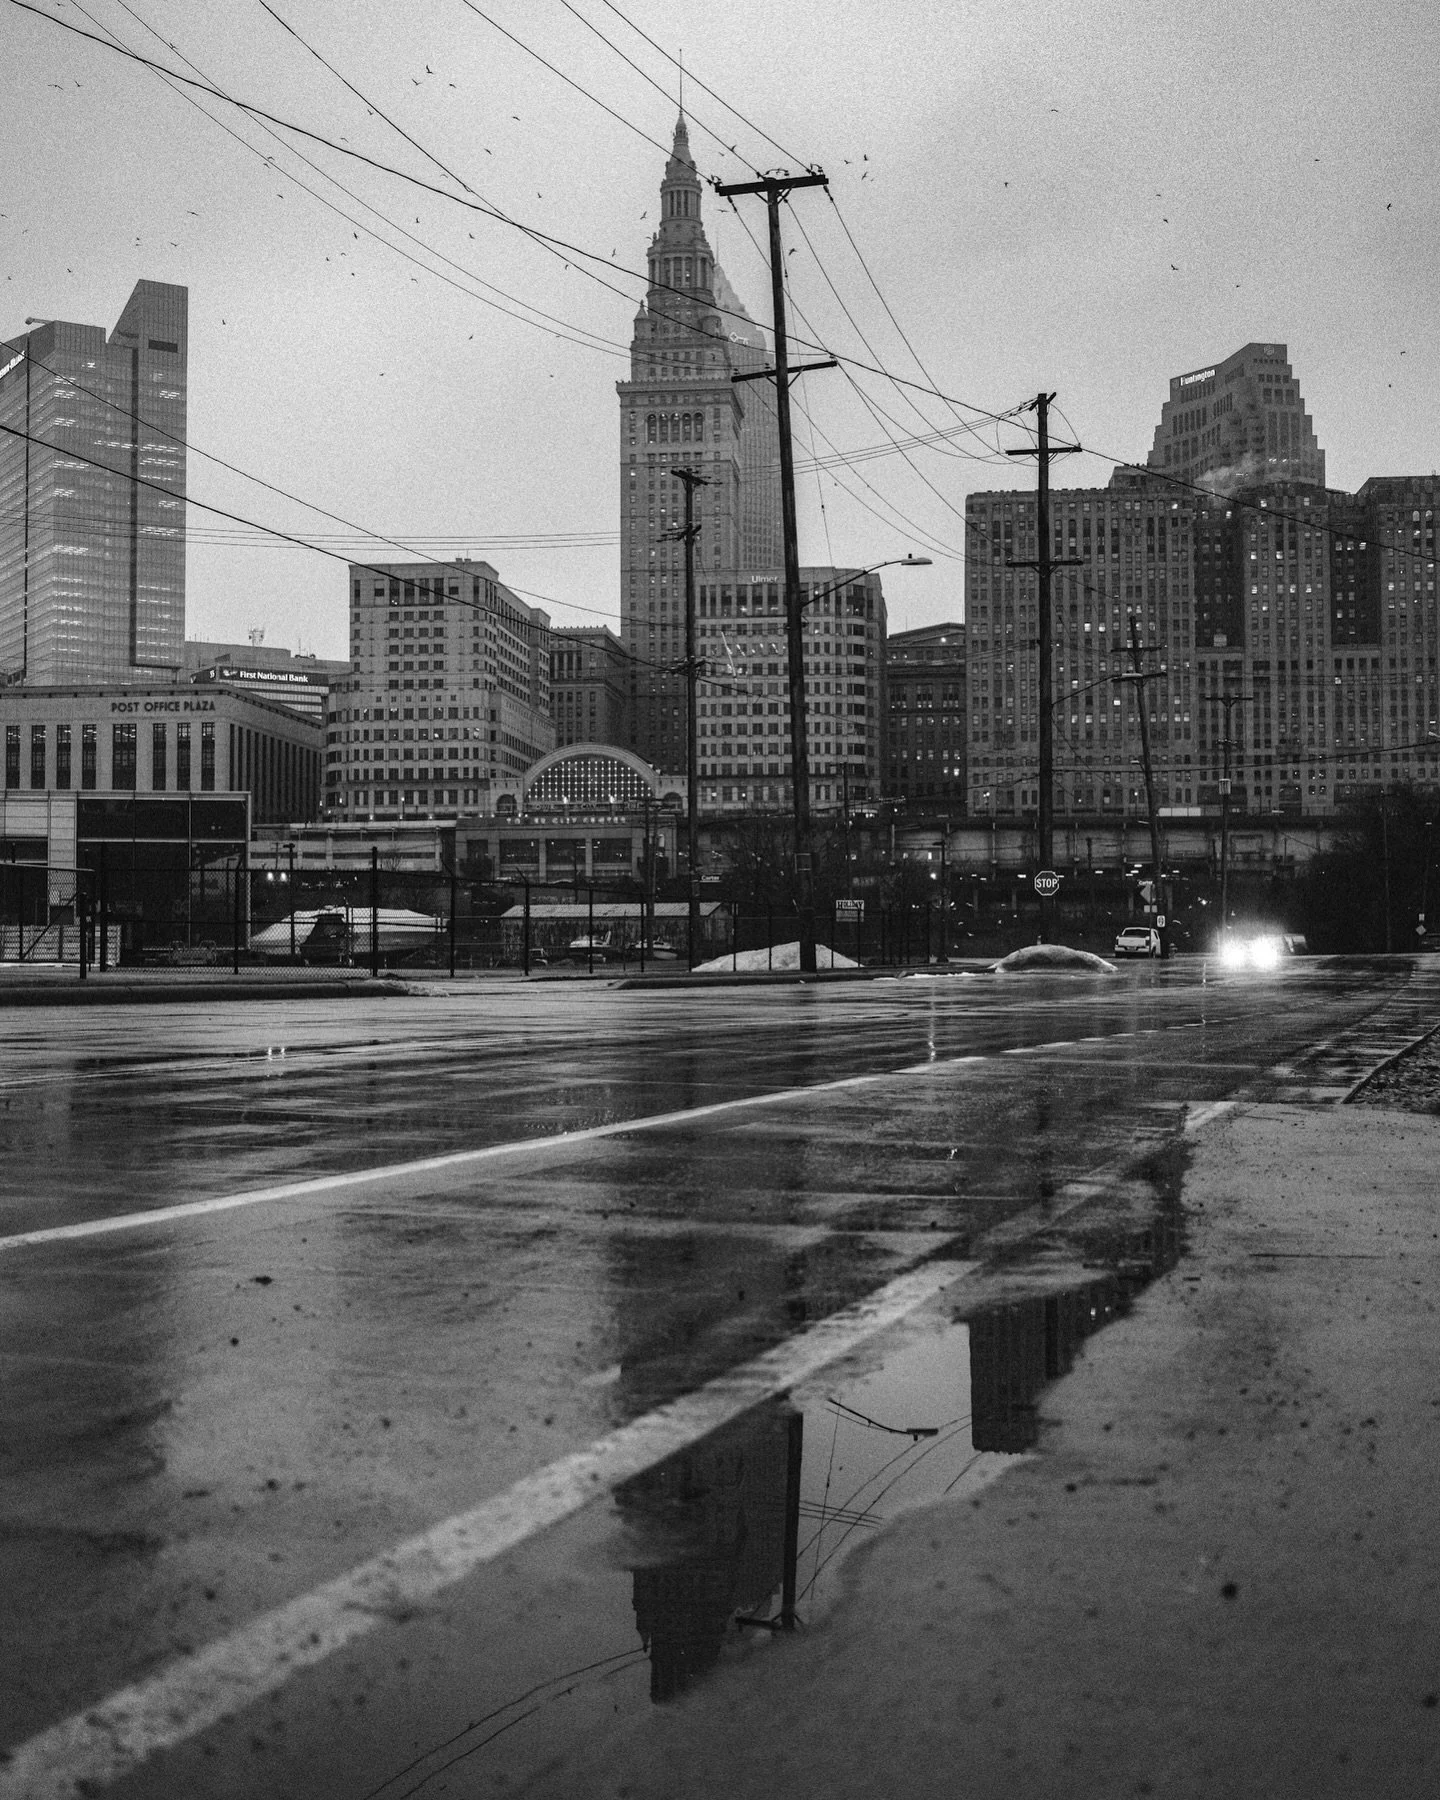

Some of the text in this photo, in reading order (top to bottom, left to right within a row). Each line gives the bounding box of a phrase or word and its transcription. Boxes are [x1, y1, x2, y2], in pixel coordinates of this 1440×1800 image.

[1180, 369, 1215, 386] Huntington
[751, 575, 778, 583] Ulmer
[239, 670, 309, 683] First National Bank
[111, 699, 216, 713] POST OFFICE PLAZA
[1036, 878, 1058, 888] STOP
